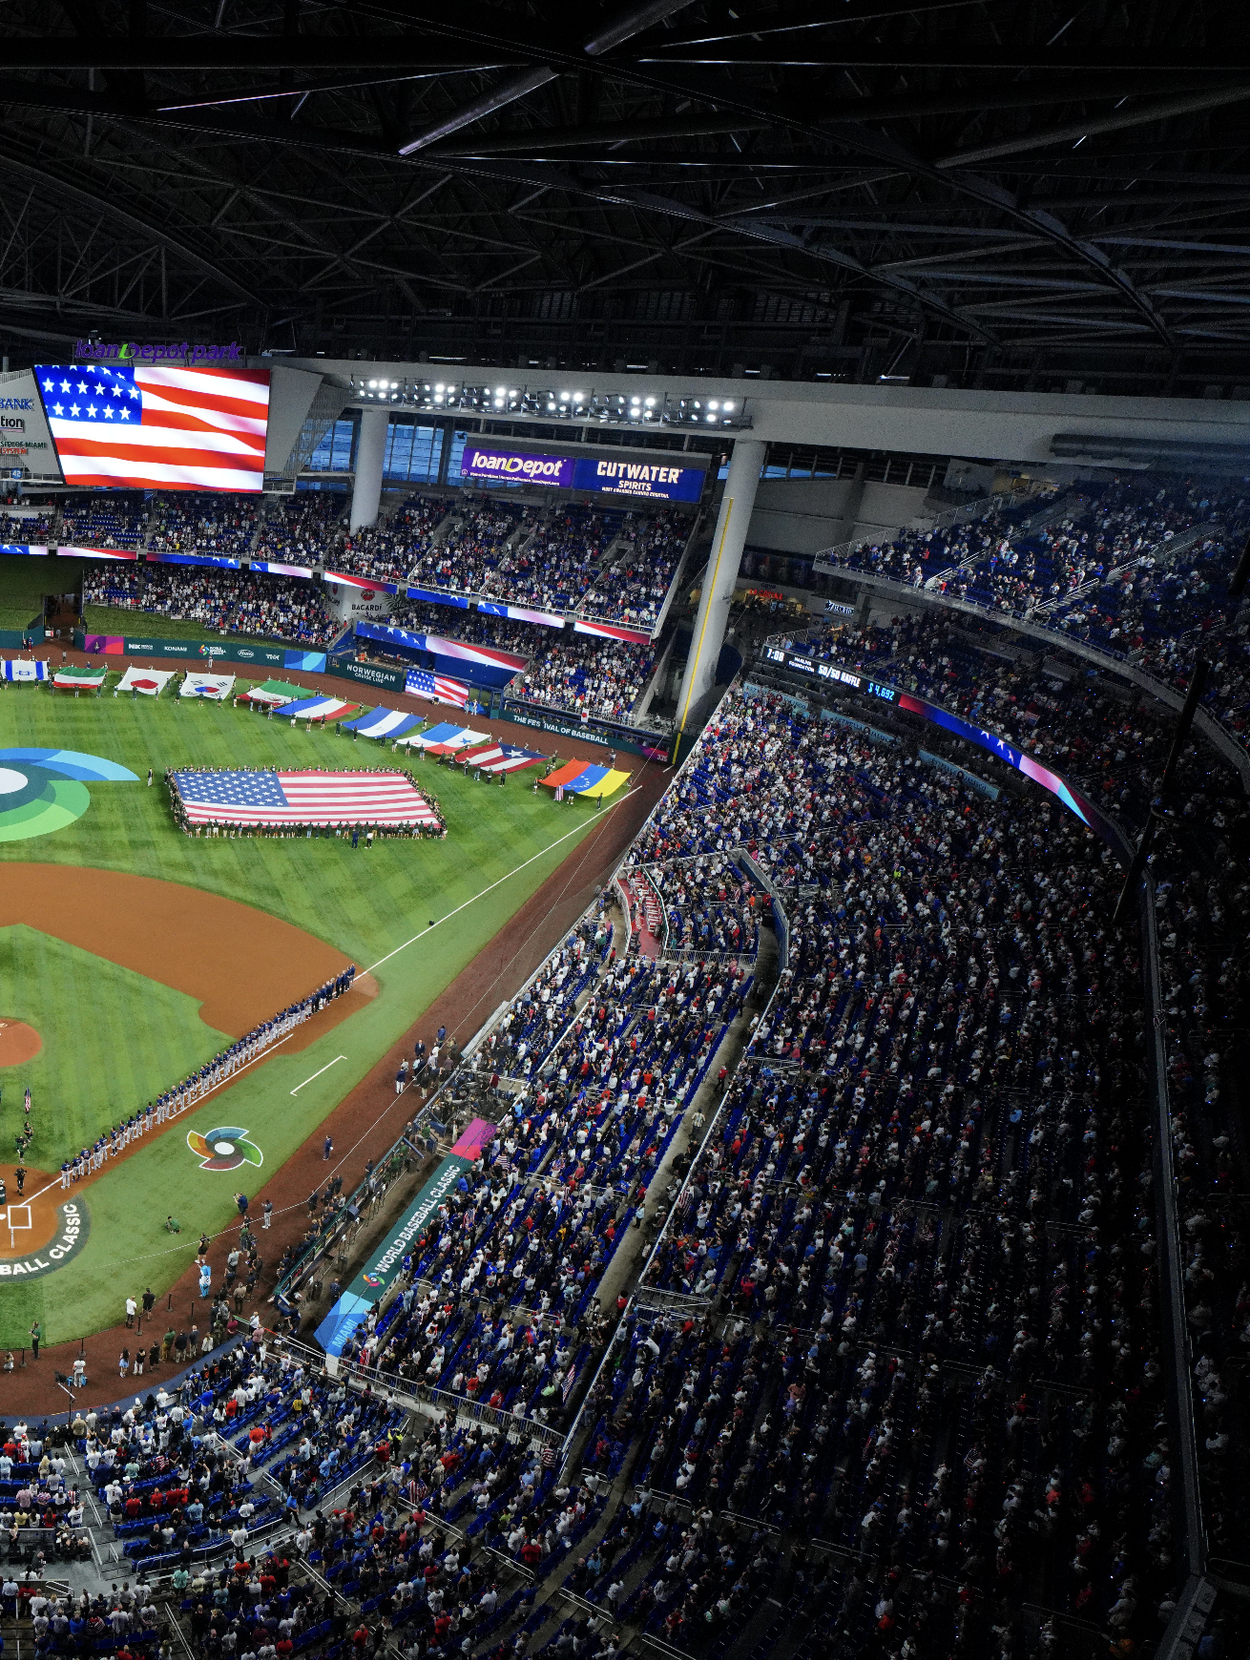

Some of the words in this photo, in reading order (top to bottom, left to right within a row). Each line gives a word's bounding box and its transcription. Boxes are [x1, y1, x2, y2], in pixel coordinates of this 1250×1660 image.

[75, 340, 189, 363] loanDepot
[191, 342, 242, 363] park
[471, 451, 563, 478] loanDepot
[597, 461, 680, 484] CUTWATER
[618, 480, 652, 491] SPIRITS
[347, 664, 396, 682] NORWEGIAN
[840, 672, 861, 688] RAFFLE
[513, 715, 527, 725] THE
[527, 717, 559, 733] FESIVAL
[560, 727, 571, 735] OF
[571, 729, 608, 745] BASEBALL
[375, 1238, 408, 1274] WORLD
[402, 1197, 438, 1241] BASEBALL
[430, 1165, 460, 1199] CLASSIC
[49, 1203, 81, 1260] CLASSIC
